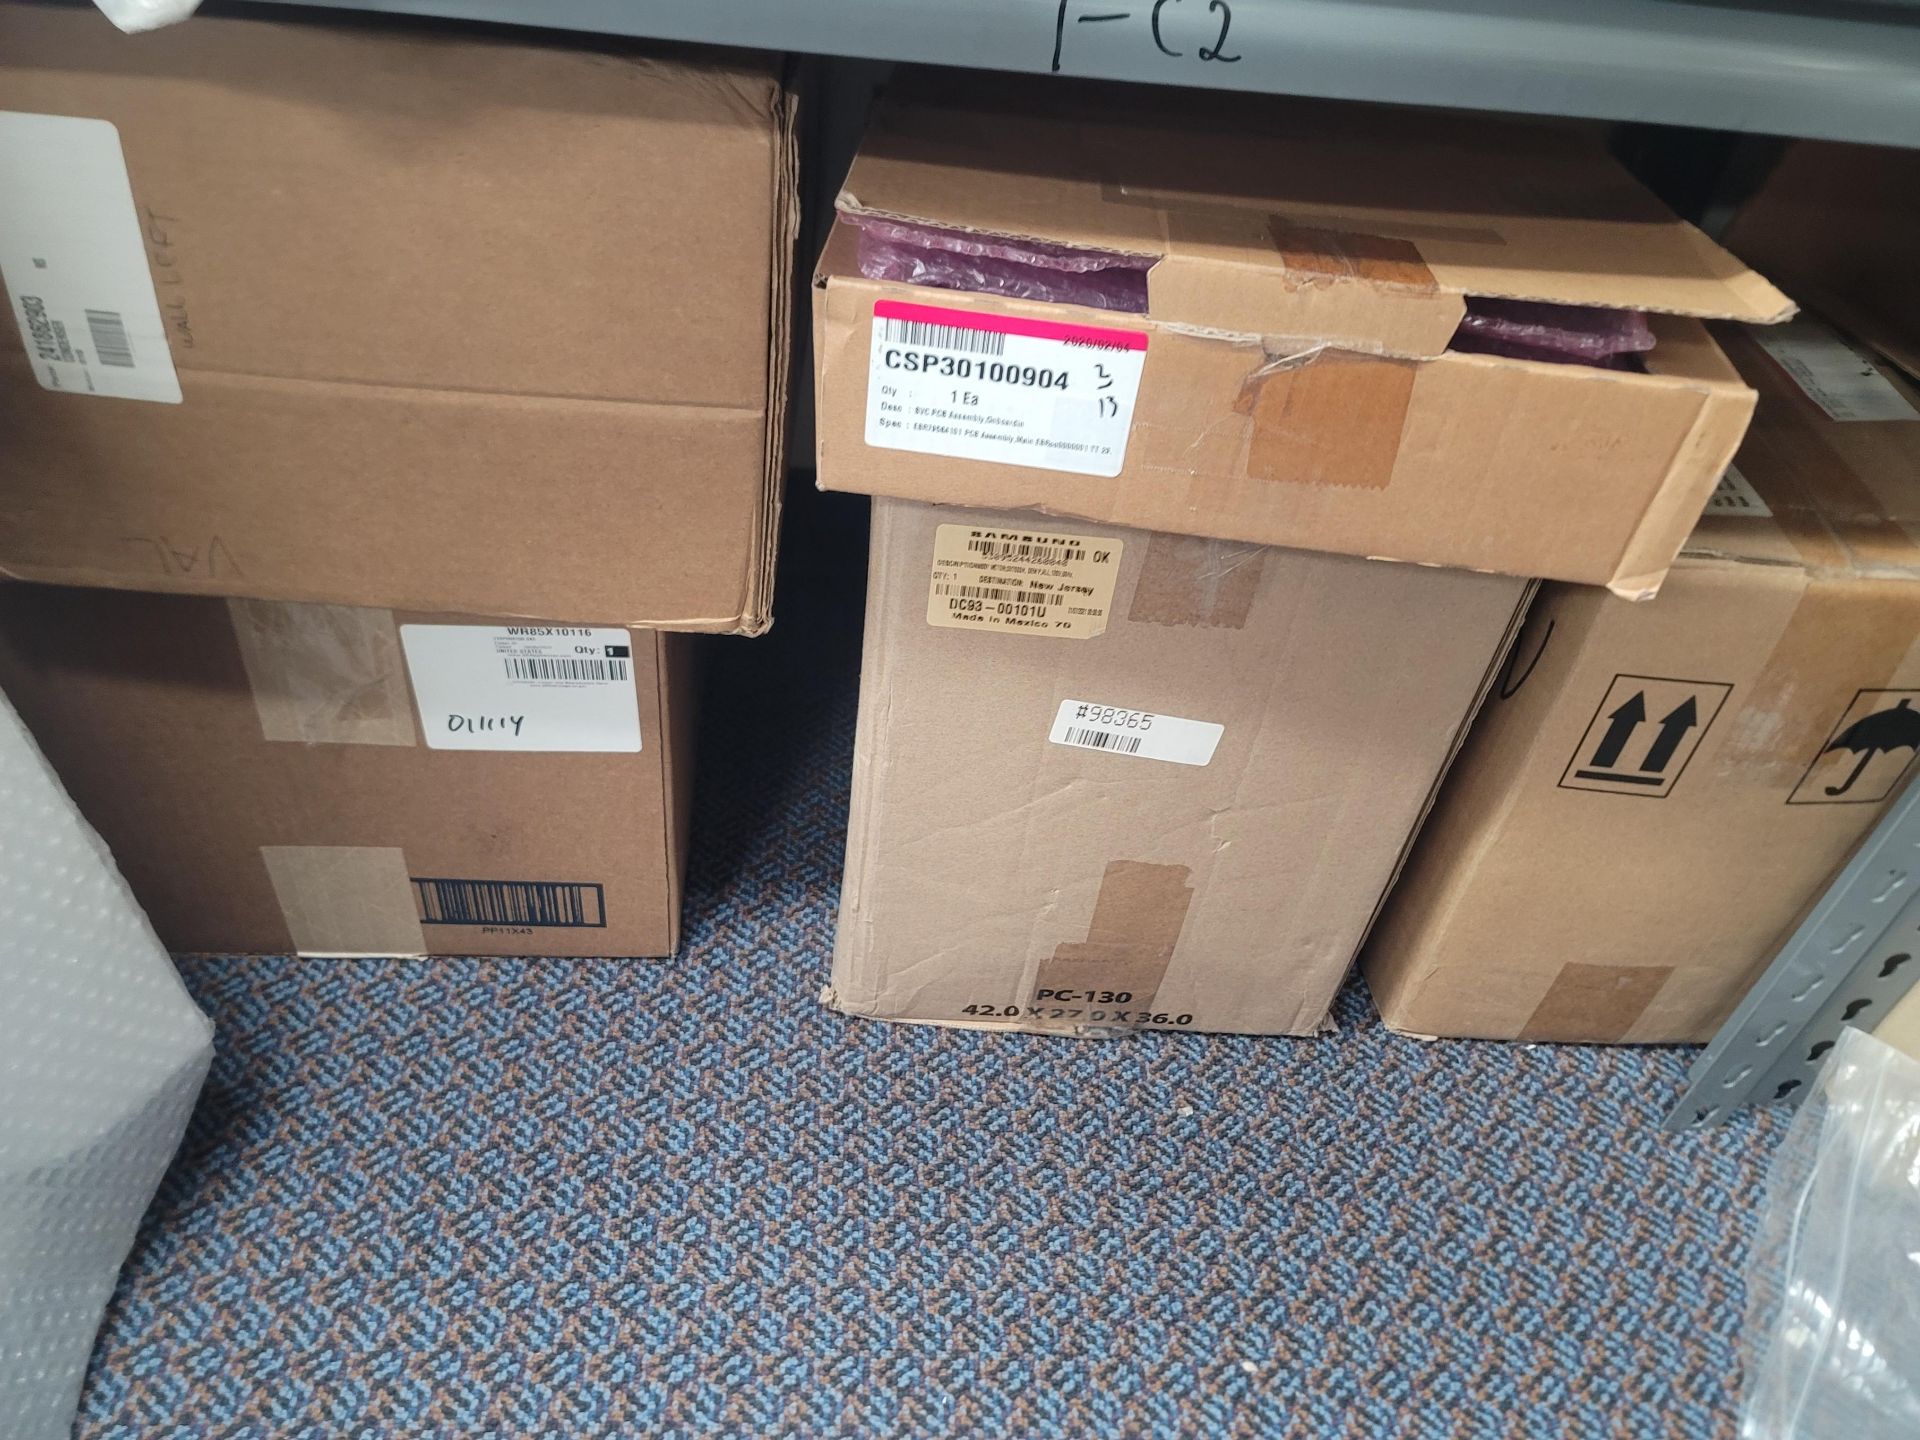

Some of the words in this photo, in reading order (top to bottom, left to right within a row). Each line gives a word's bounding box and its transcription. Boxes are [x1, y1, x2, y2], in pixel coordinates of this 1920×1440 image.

[884, 349, 1070, 390] CSP30100904
[881, 385, 898, 398] Qty
[951, 390, 957, 403] 1
[963, 391, 979, 406] Ea
[880, 417, 902, 429] Spec
[1093, 550, 1111, 564] OK
[1029, 580, 1054, 590] New
[1057, 583, 1094, 597] Jersey
[952, 613, 984, 622] Made
[1005, 618, 1048, 629] Mexico
[507, 627, 592, 637] WR85X10116
[574, 645, 600, 655] Qty:
[1075, 704, 1155, 731] #98365
[482, 927, 534, 936] PP11X43
[1036, 989, 1133, 1004] PC-130
[961, 1004, 1020, 1017] 42.0
[1050, 1007, 1106, 1022] 270
[1136, 1012, 1193, 1026] 36.0
